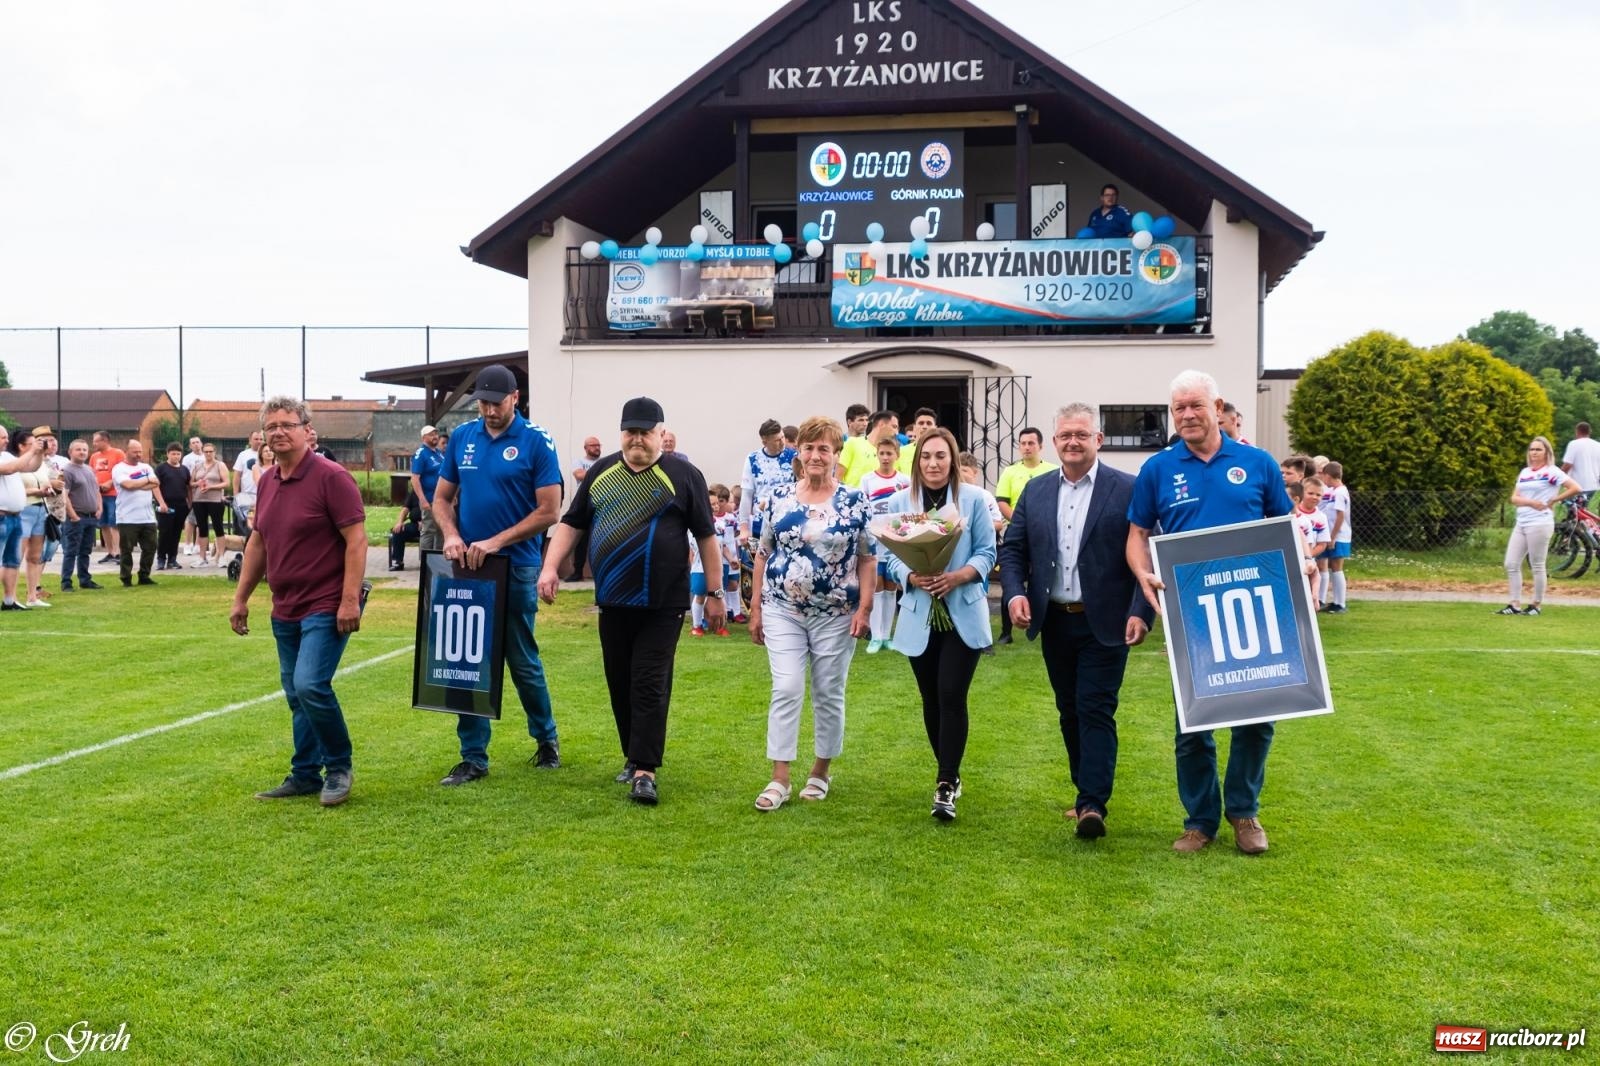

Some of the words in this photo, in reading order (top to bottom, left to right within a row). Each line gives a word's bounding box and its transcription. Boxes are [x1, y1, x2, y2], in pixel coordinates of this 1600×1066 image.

[853, 1, 902, 24] LKS
[835, 31, 917, 55] 1920
[768, 59, 984, 89] KRZYŻANOWICE
[853, 151, 911, 178] 00:00
[800, 190, 874, 202] KRZYŻANOWICE
[890, 189, 928, 200] GÓRNIK
[702, 208, 733, 240] BINGO
[819, 210, 836, 241] 0
[925, 207, 941, 238] 0
[1032, 200, 1065, 237] BINGO
[706, 246, 734, 259] MYŚLĄ
[736, 248, 742, 257] O
[745, 247, 770, 257] TOBIE
[886, 253, 931, 278] LKS
[936, 248, 1133, 278] KRZYŻANOWICE
[1023, 282, 1134, 301] 1920-2020
[838, 304, 907, 326] Naszego
[914, 302, 964, 321] Klubu
[1204, 572, 1232, 587] EMILIA
[1233, 567, 1260, 582] KUBIK
[446, 588, 457, 599] JAN
[457, 589, 473, 600] KUBIK
[433, 604, 485, 664] 100
[1197, 585, 1283, 663] 101
[433, 668, 442, 679] LKS
[442, 668, 481, 682] KRZYŻANOWICE
[1207, 673, 1225, 687] LKS
[1225, 663, 1290, 684] KRZYŻANOWICE
